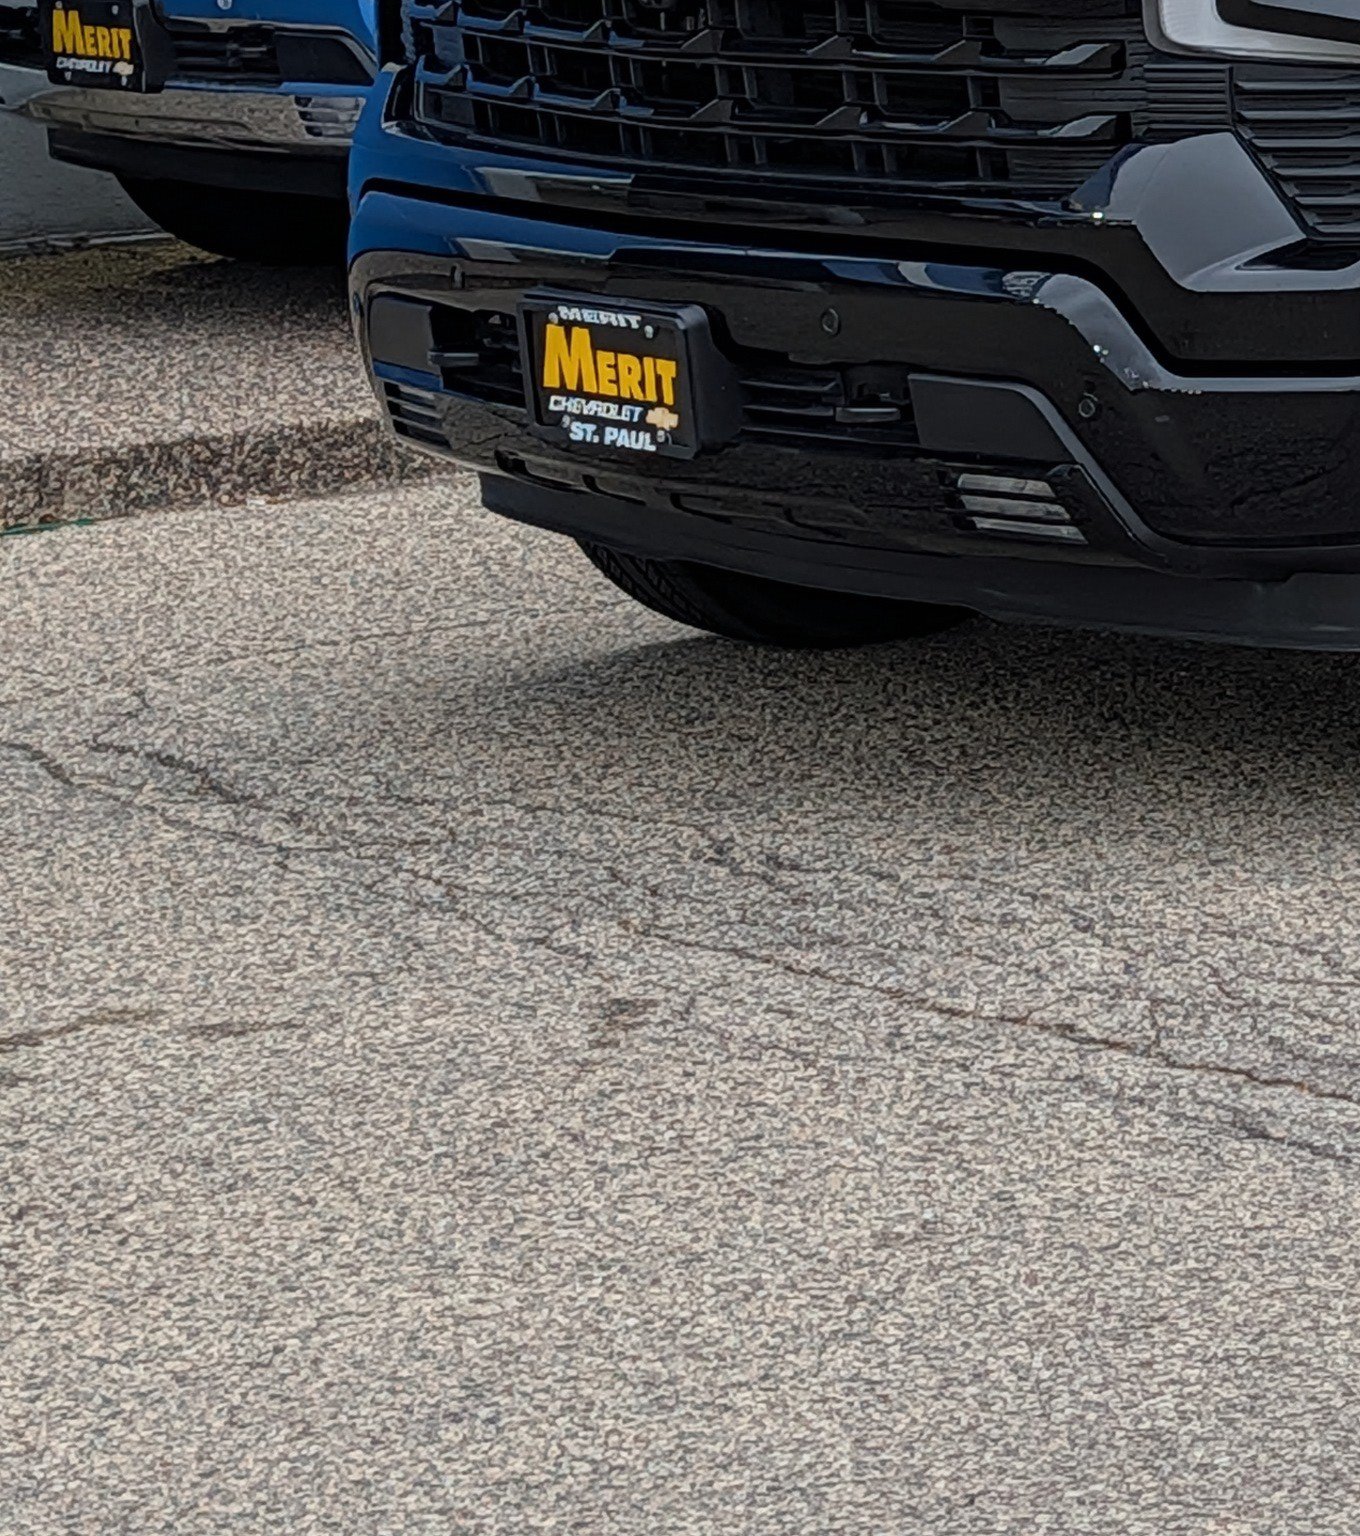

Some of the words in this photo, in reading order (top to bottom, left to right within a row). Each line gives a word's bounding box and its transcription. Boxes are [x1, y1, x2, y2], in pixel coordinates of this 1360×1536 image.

[53, 9, 131, 60] MERIT
[557, 306, 642, 329] MERIT
[543, 323, 677, 406] MERIT
[549, 395, 644, 422] CHEVROLET
[569, 422, 599, 443] ST.
[604, 426, 657, 452] PAUL
